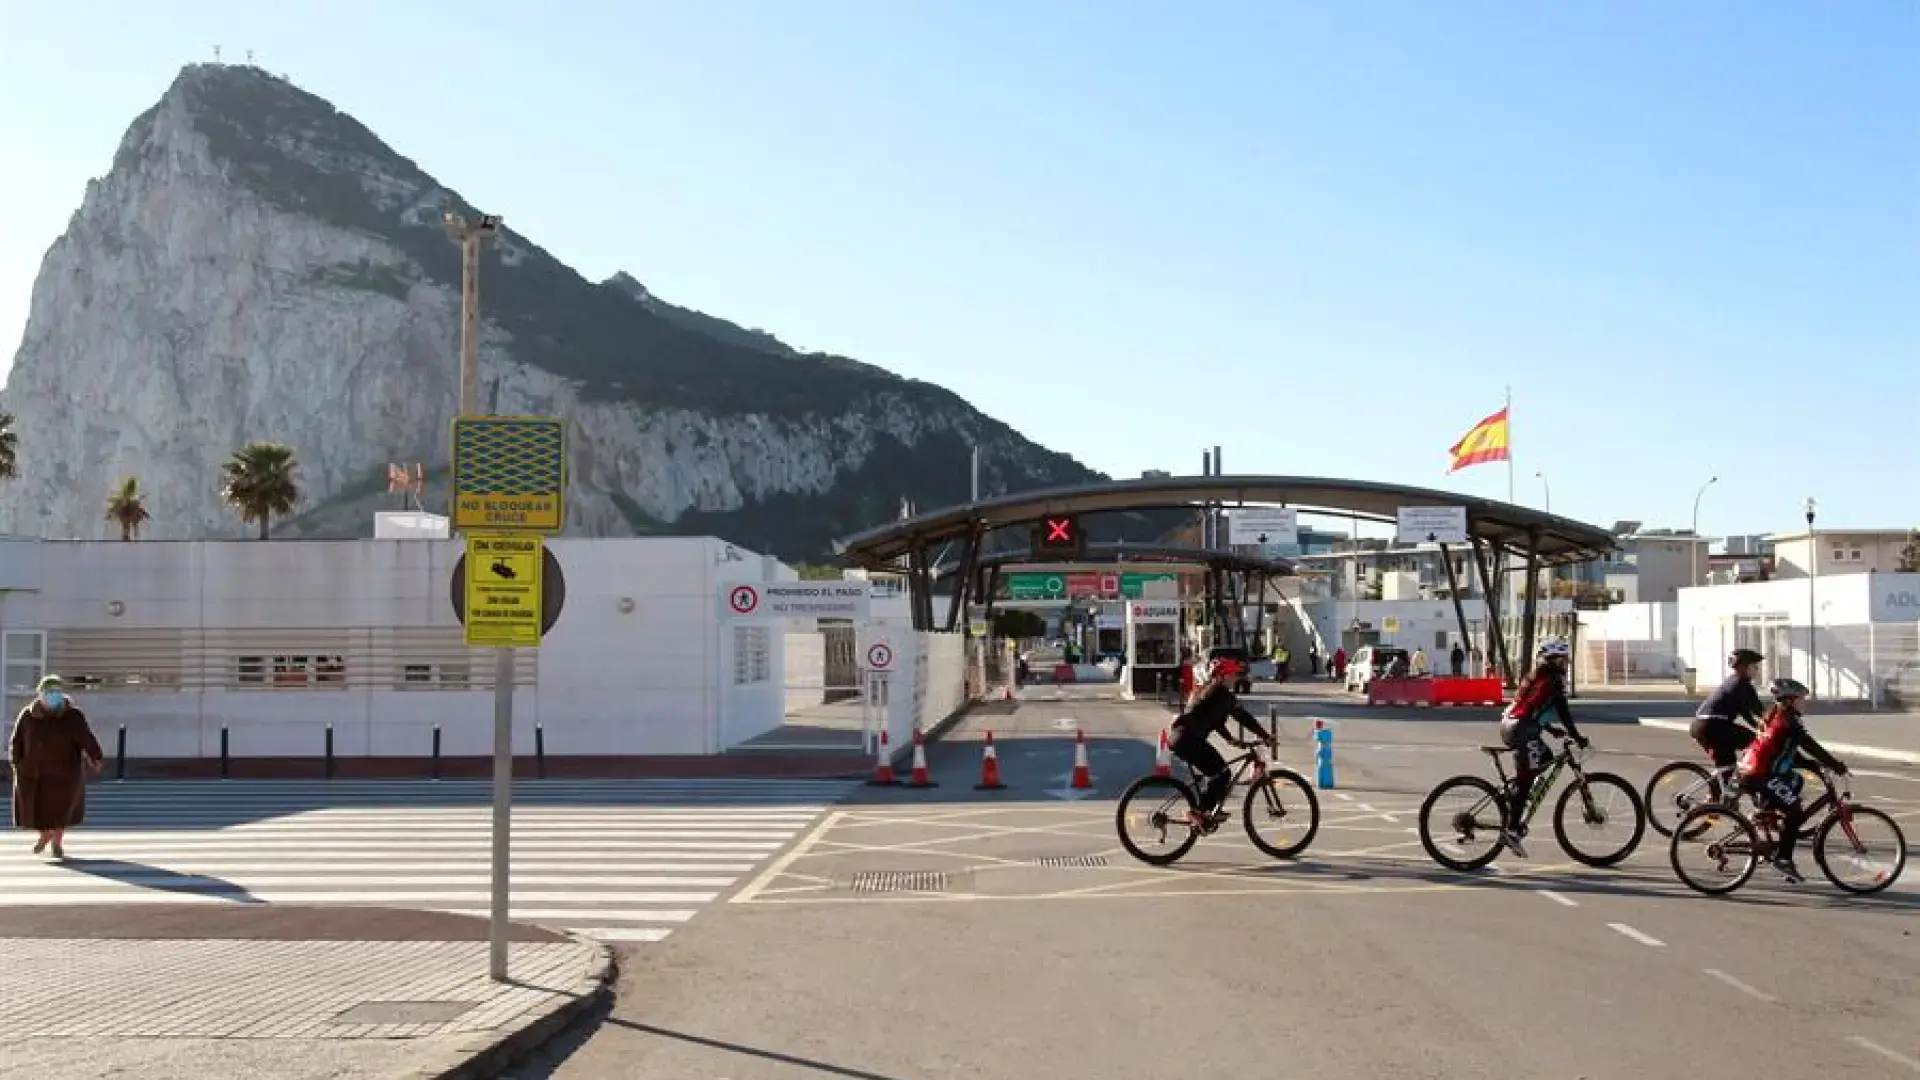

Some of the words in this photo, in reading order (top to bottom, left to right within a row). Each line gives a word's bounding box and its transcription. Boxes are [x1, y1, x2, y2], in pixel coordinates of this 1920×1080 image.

[461, 500, 479, 511] NO
[484, 501, 552, 511] BLOQUEAR
[485, 511, 527, 522] CRUCE
[821, 588, 833, 597] EL
